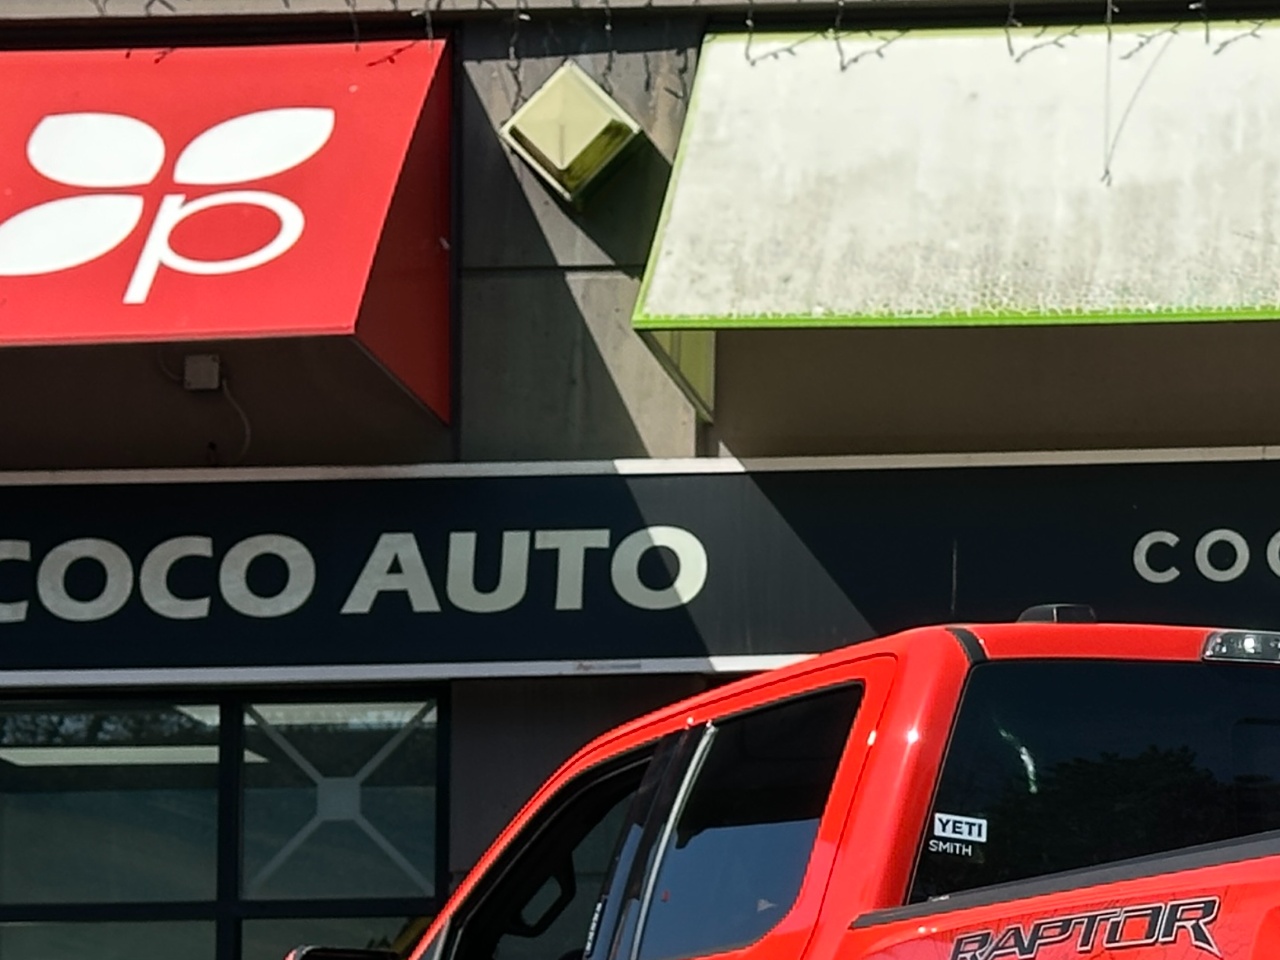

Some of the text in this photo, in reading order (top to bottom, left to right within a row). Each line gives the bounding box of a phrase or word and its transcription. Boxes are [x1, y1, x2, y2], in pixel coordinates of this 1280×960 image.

[341, 525, 709, 614] AUTO
[937, 817, 983, 838] YETI
[928, 839, 972, 856] SMITH
